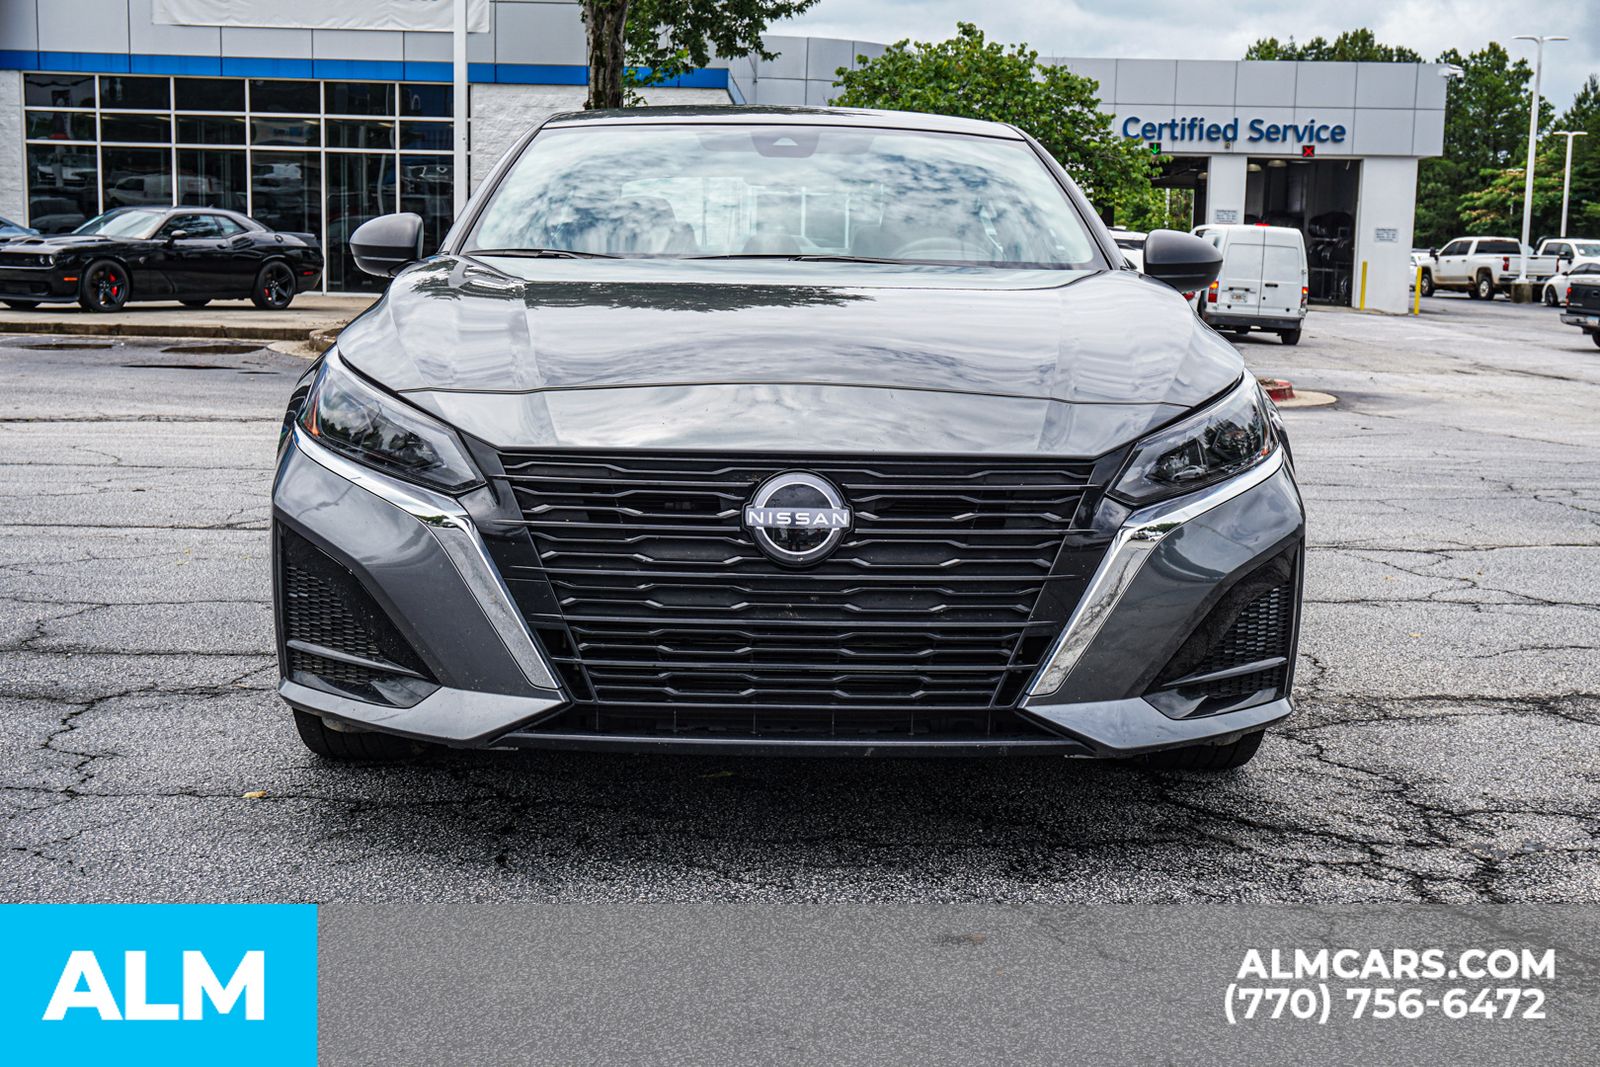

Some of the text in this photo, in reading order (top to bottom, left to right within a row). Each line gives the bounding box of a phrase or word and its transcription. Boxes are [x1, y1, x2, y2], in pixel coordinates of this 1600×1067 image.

[1122, 116, 1347, 143] Certified Service
[749, 510, 848, 526] NISSAN
